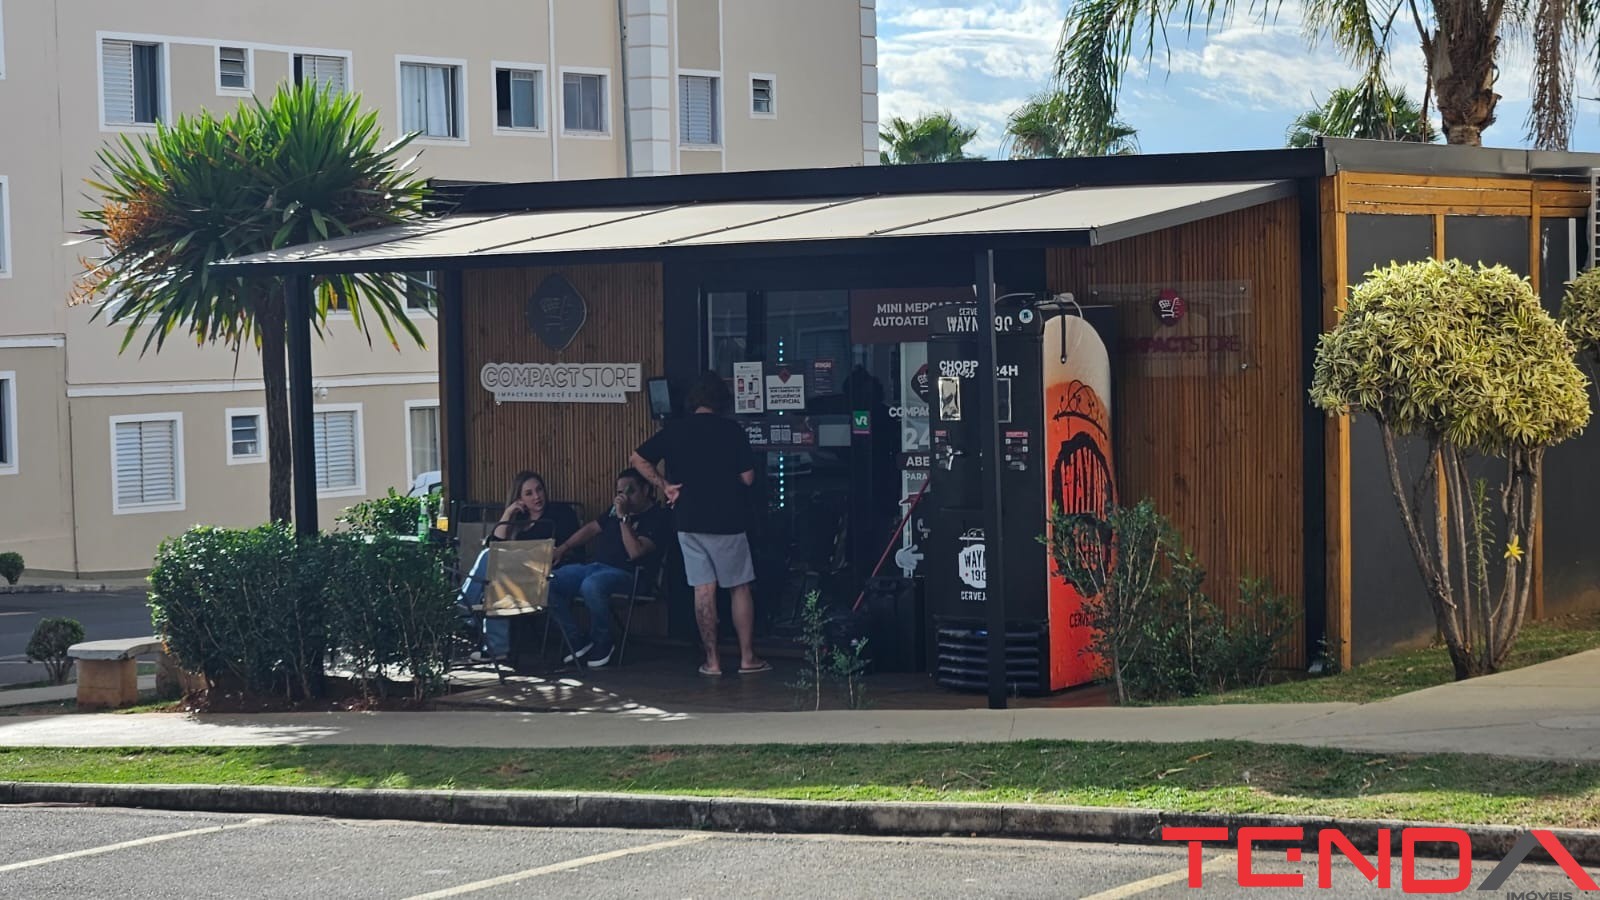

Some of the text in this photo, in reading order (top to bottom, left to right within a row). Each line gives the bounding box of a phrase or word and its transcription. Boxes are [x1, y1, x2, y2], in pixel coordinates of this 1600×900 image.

[877, 303, 902, 314] MINI
[959, 308, 978, 316] CERVE
[873, 315, 928, 327] AUTOATE
[946, 316, 979, 332] WAYN
[547, 390, 566, 398] VOCÊ
[906, 456, 930, 467] ABE
[905, 472, 928, 481] PARA
[964, 550, 986, 568] WAY
[961, 590, 987, 601] CERVEJ
